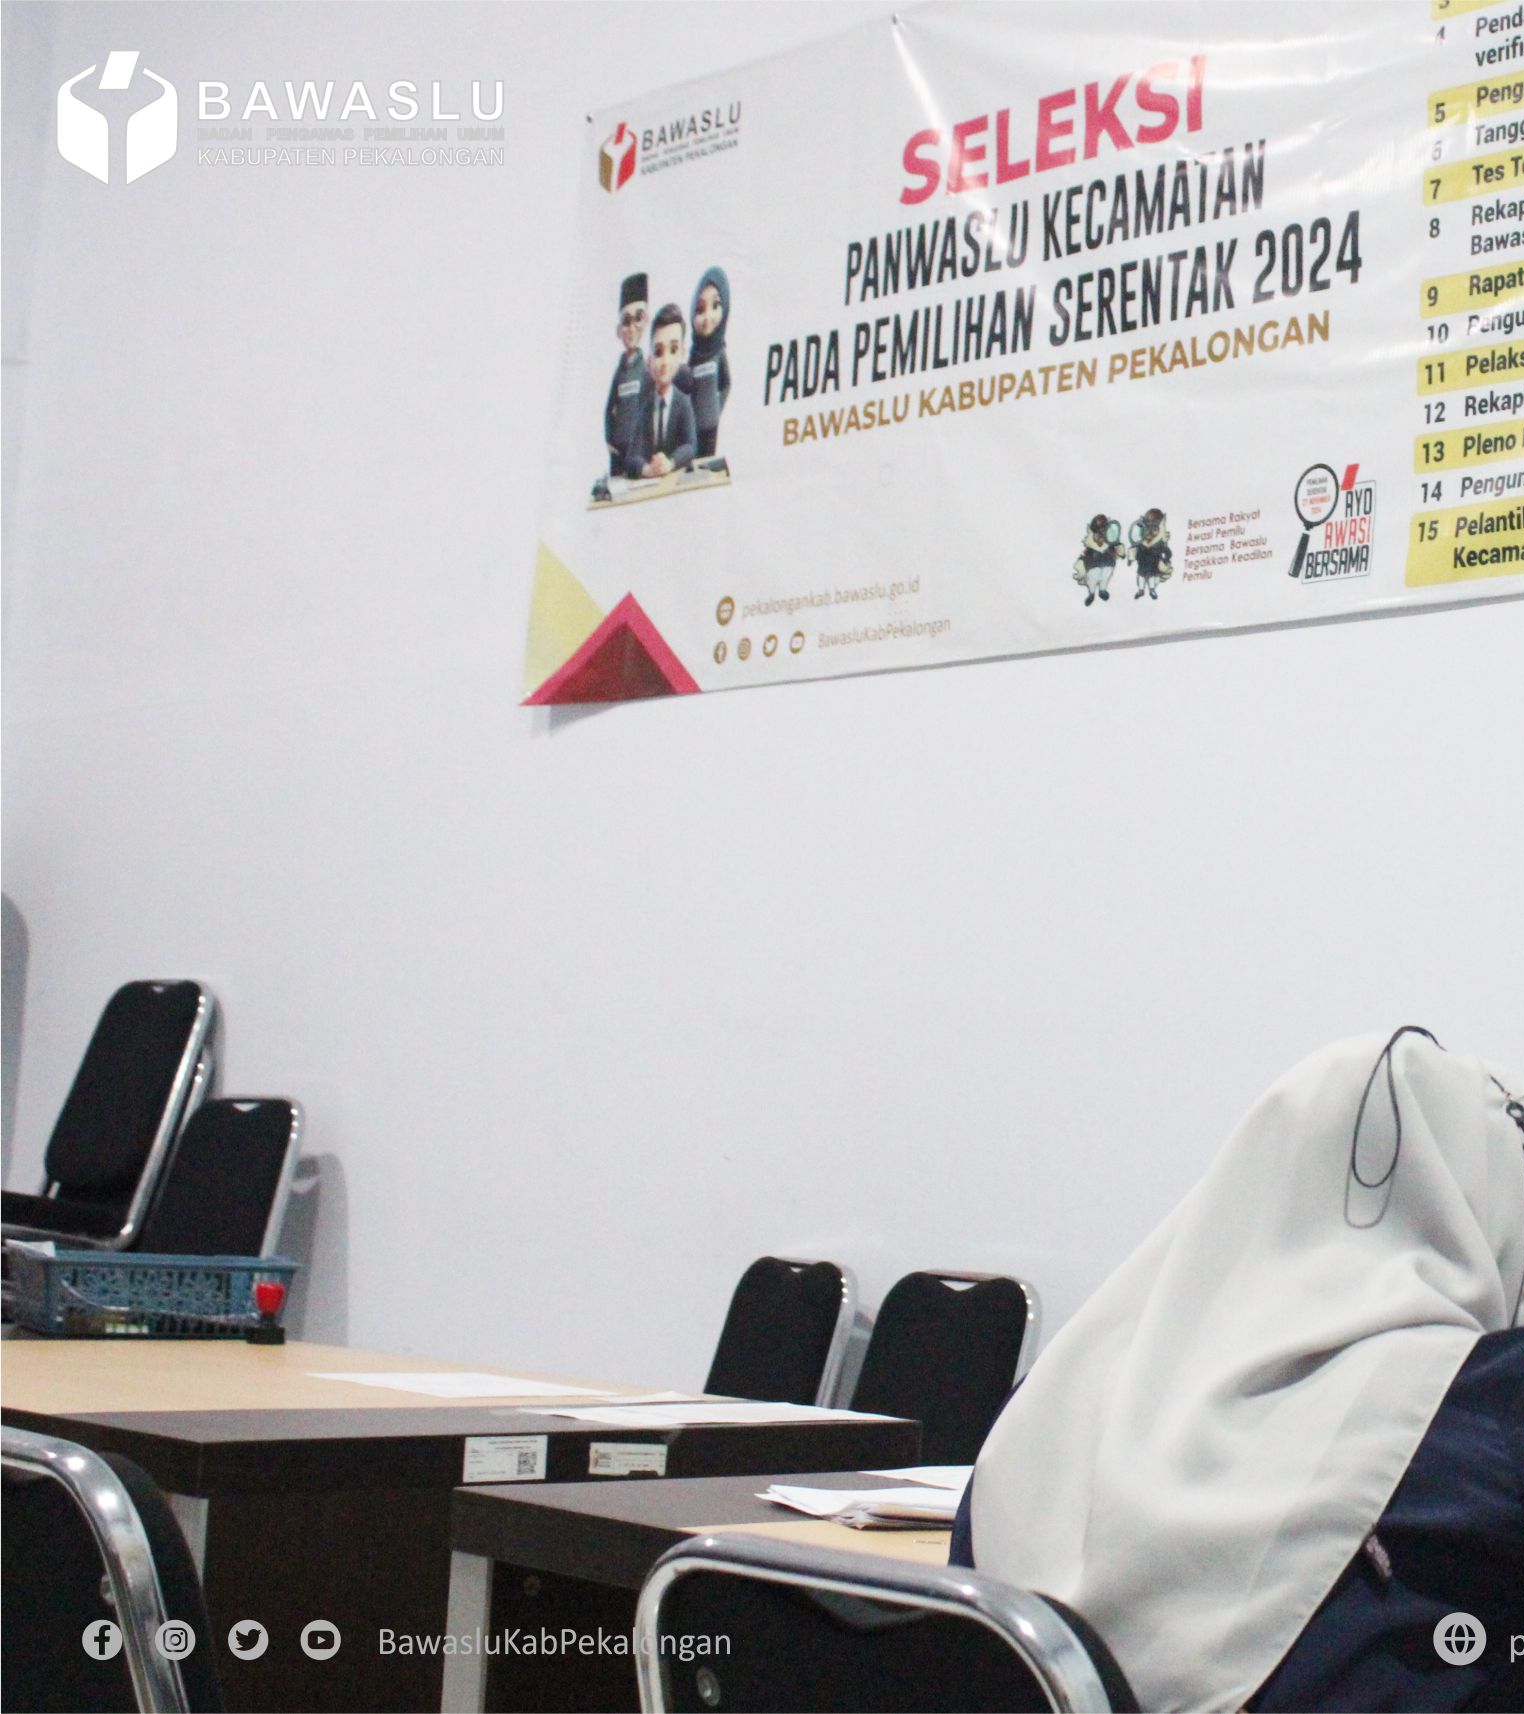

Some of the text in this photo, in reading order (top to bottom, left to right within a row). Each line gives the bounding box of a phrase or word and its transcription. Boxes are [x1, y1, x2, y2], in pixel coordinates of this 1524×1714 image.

[642, 101, 742, 151] BAWASLU
[1434, 103, 1446, 123] 5
[899, 54, 1207, 206] SELEKSI
[1430, 179, 1442, 200] 7
[1472, 164, 1505, 185] Tes
[845, 139, 1267, 306] PANWASLU KECAMATAN
[1429, 218, 1440, 239] 8
[1427, 286, 1439, 307] 9
[1469, 266, 1524, 298] Rapat
[764, 210, 1363, 407] PADA PEMILIHAN SERENTAK 2024
[1426, 323, 1449, 345] 10
[782, 310, 1331, 447] BAWASLU KABUPATEN PEKALONGAN
[1425, 362, 1445, 385] 11
[1424, 402, 1446, 424] 12
[1422, 441, 1445, 464] 13
[1463, 432, 1516, 457] Pleno
[1345, 487, 1373, 518] AYO
[1421, 481, 1442, 503] 14
[1187, 509, 1260, 530] Bersama Rakyat
[1215, 525, 1246, 538] Pemilu
[1323, 516, 1371, 549] AWASI
[1418, 520, 1439, 542] 15
[1185, 535, 1268, 557] Bersama Bawaslu
[1184, 555, 1230, 570] Tegakkan
[1304, 544, 1370, 579] BERSAMA
